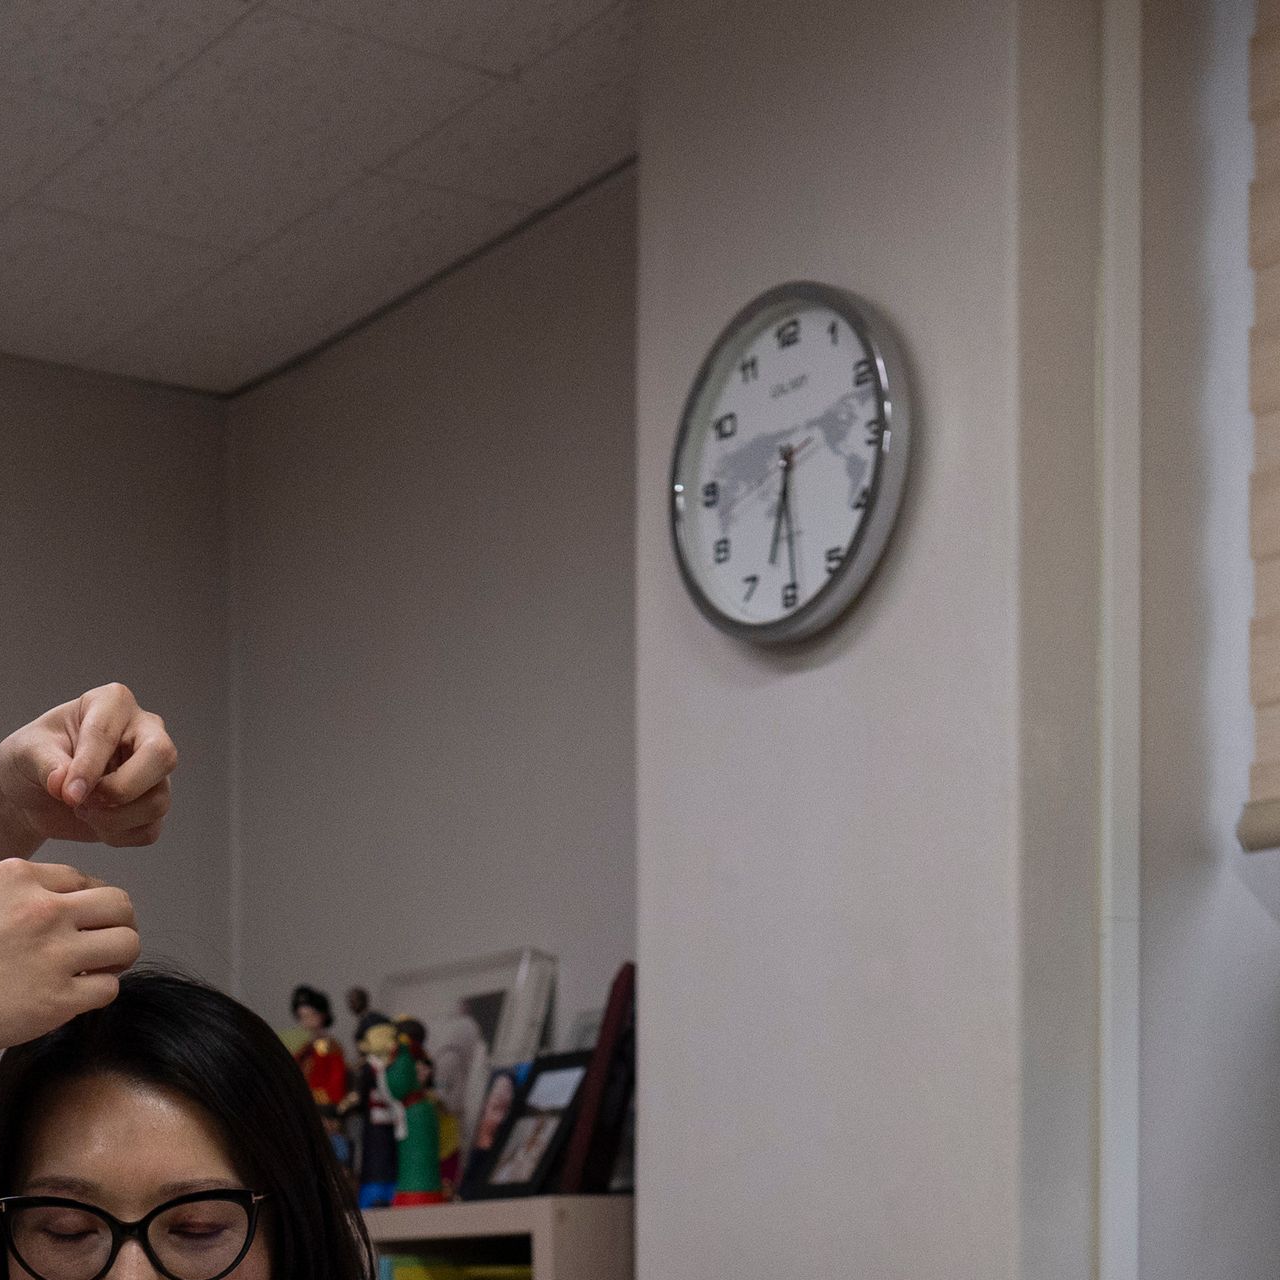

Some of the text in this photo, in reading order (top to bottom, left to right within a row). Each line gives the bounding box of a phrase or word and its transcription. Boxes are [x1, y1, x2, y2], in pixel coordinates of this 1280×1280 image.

[775, 318, 801, 349] 12
[827, 320, 839, 347] 1
[739, 355, 759, 384] 11
[852, 359, 875, 388] 2
[713, 411, 737, 441] 10
[703, 480, 719, 509] 9
[714, 537, 731, 564] 8
[825, 546, 846, 575] 5
[743, 573, 760, 603] 7
[782, 581, 798, 609] 6
